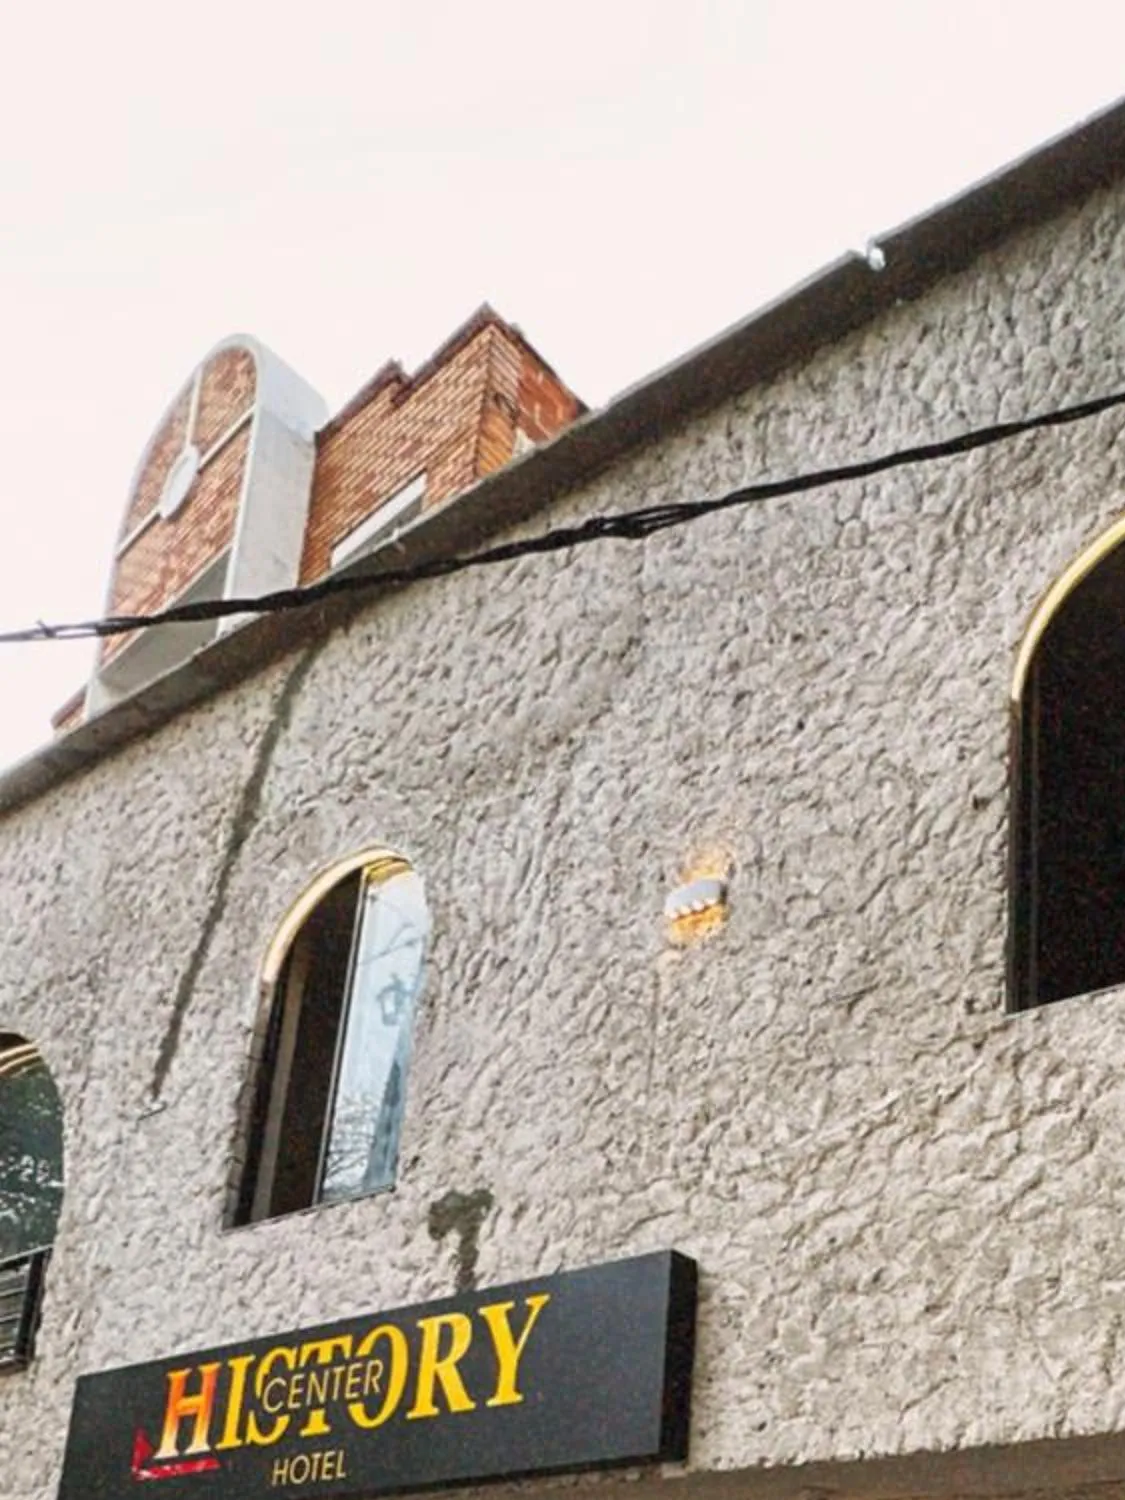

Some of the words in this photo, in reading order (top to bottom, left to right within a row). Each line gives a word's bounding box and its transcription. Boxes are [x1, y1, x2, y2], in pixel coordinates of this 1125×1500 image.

[154, 1294, 550, 1459] HISTORY
[262, 1359, 384, 1413] CENTER
[272, 1450, 347, 1486] HOTEL
